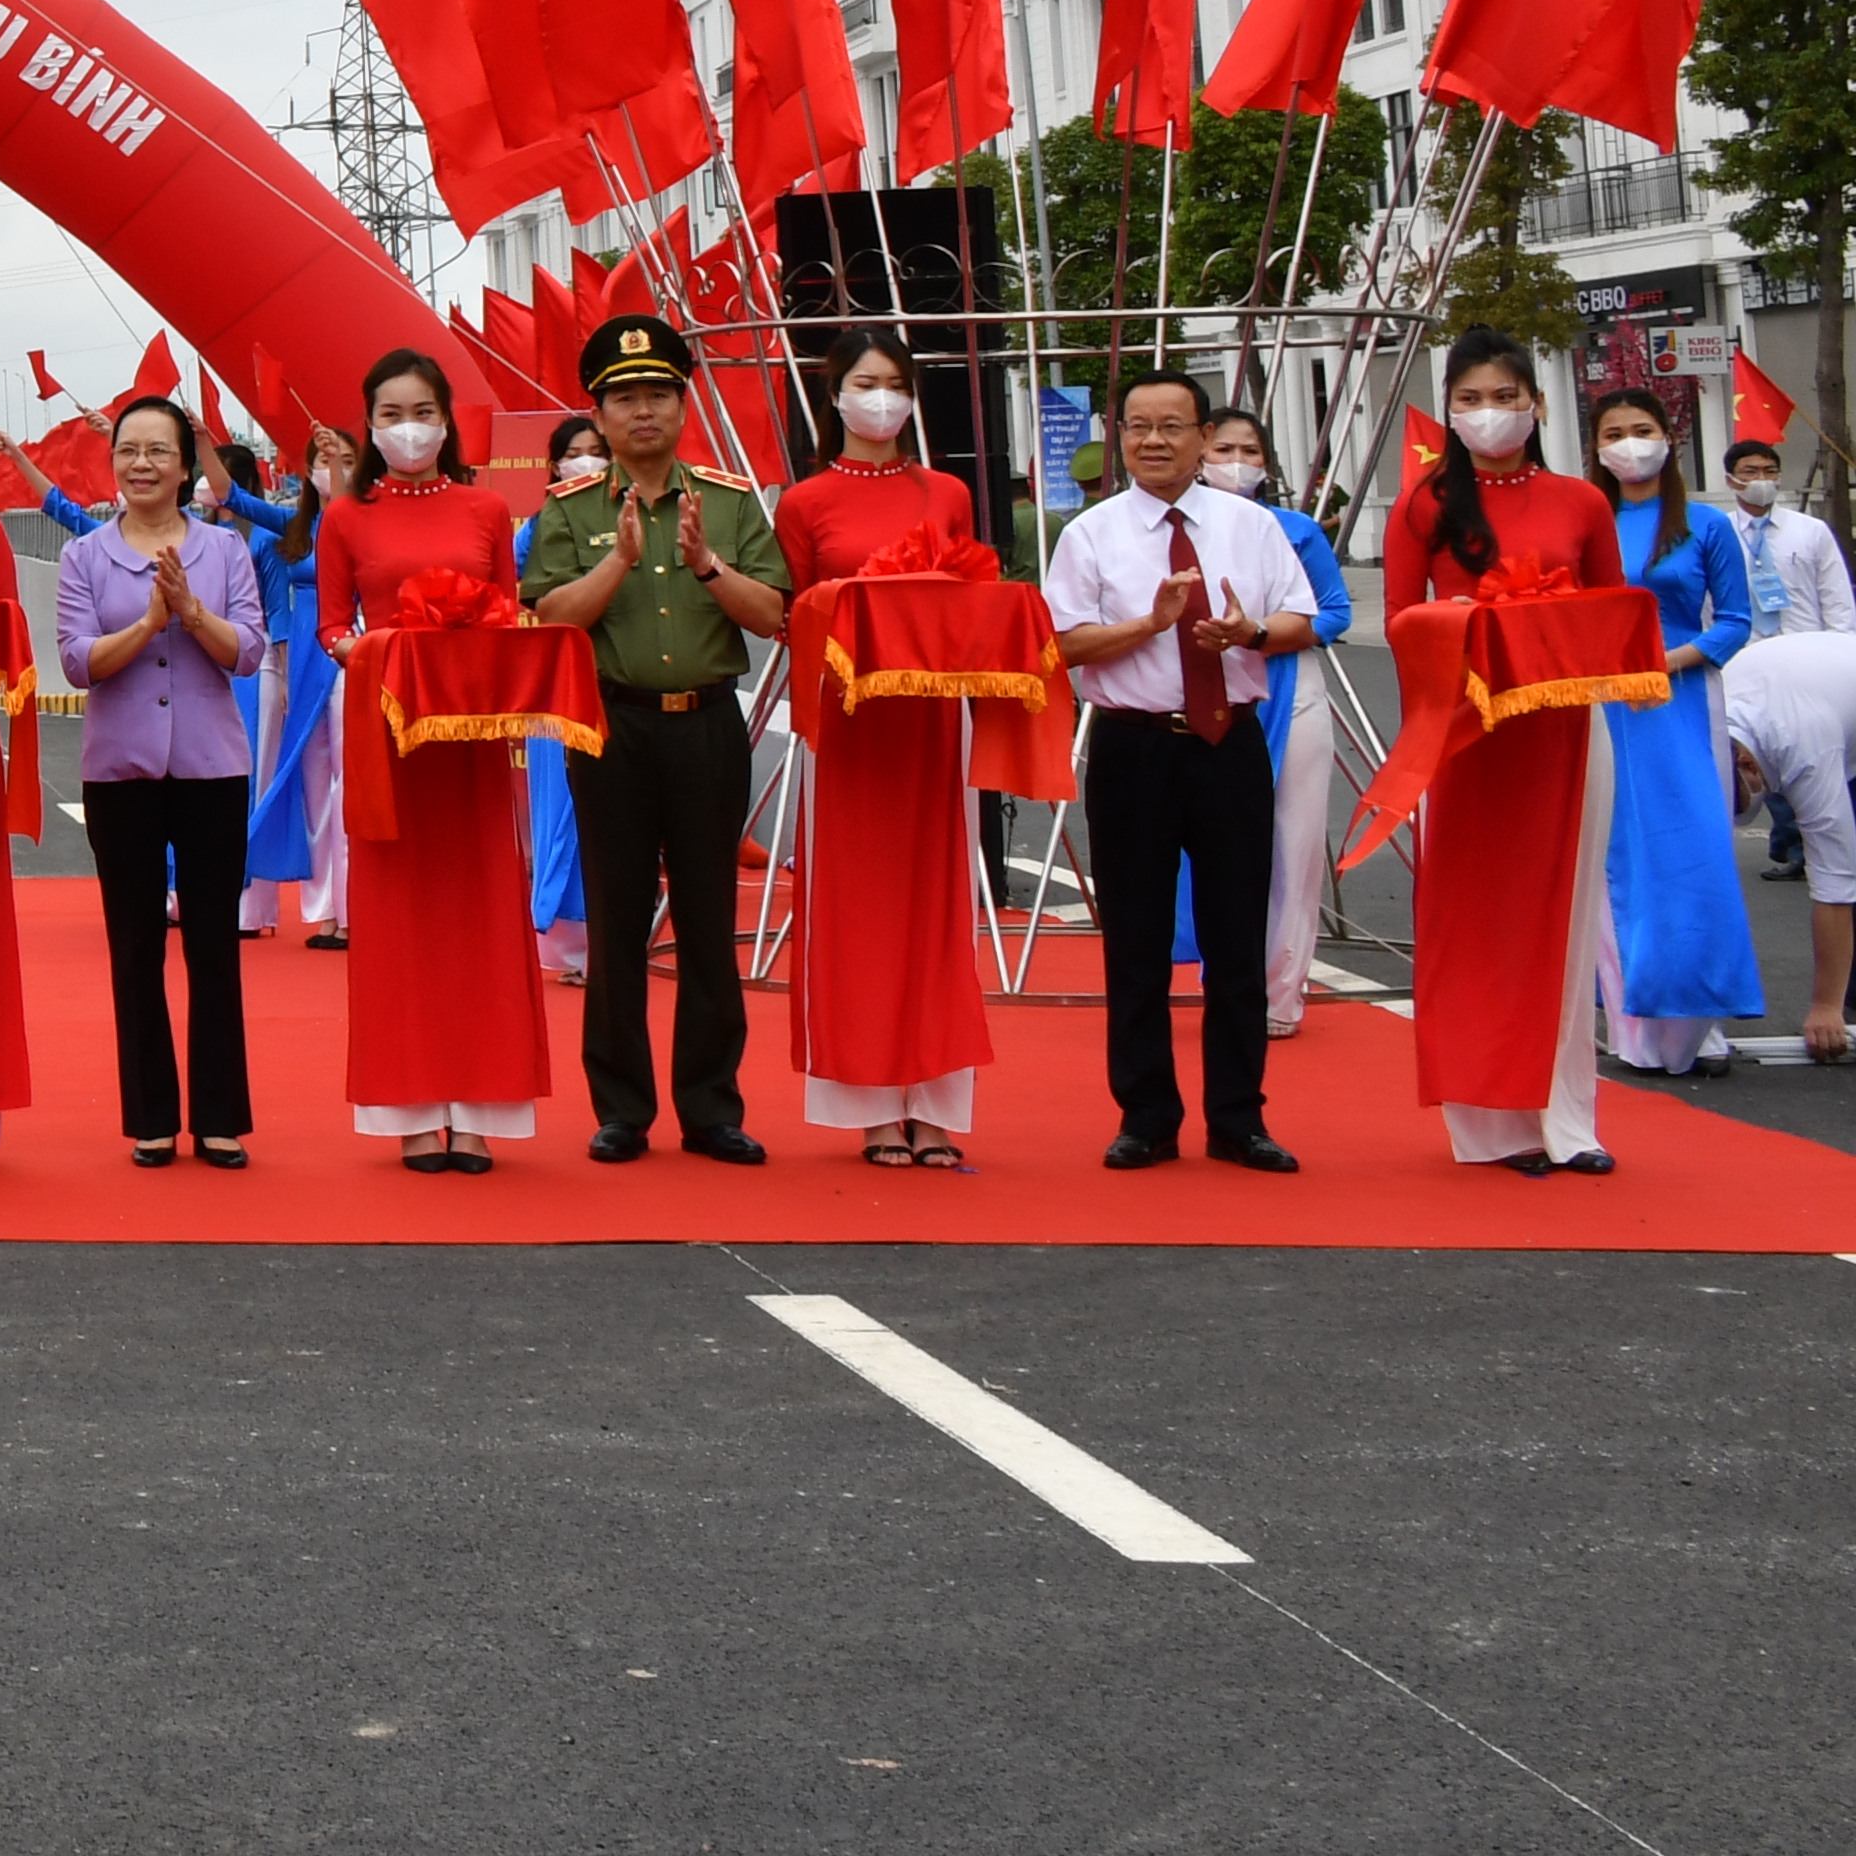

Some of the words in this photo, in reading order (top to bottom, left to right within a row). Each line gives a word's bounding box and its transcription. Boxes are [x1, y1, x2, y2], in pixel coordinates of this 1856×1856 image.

[17, 31, 167, 158] BÍNH
[1688, 337, 1721, 345] KING
[1689, 346, 1722, 355] BBQ
